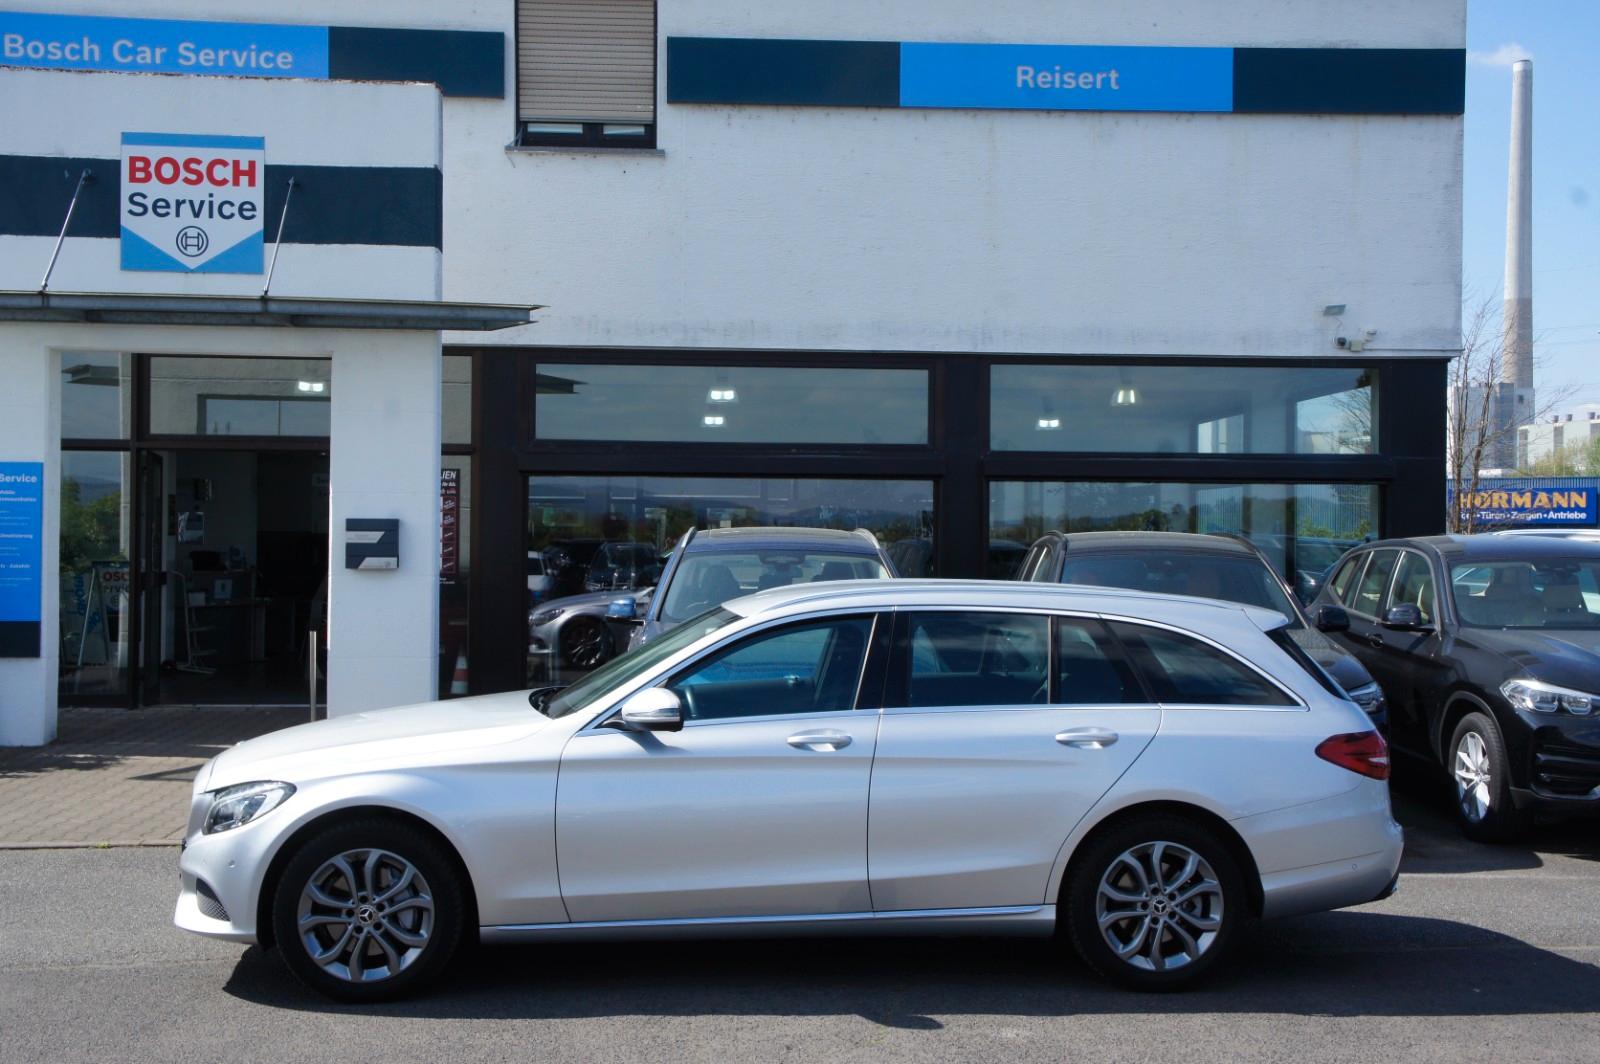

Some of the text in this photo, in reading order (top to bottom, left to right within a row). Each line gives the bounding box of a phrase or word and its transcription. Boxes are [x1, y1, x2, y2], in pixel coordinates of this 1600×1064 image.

[3, 34, 294, 69] Bosch Car Service
[1016, 65, 1120, 90] Reisert
[128, 156, 256, 187] BOSCH
[127, 192, 257, 220] Service
[1547, 510, 1588, 520] Antriebe
